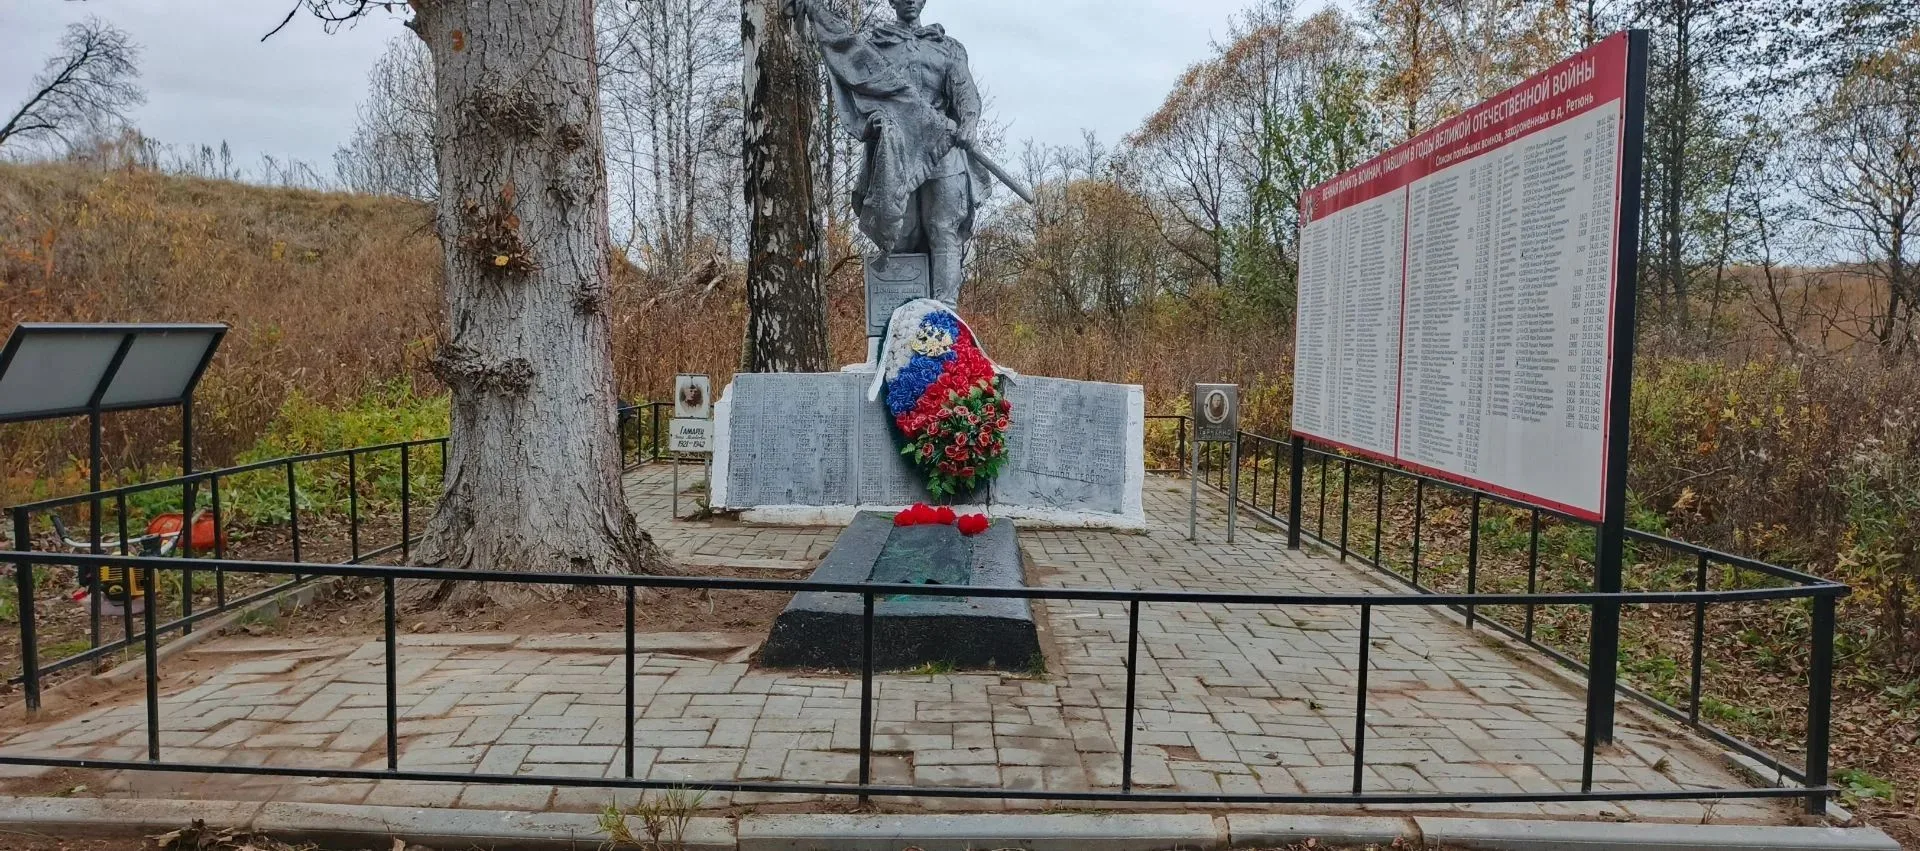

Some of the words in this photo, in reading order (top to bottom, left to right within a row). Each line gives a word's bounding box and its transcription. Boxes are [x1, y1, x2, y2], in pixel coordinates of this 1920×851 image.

[1339, 174, 1358, 193] ПАМЯТЬ
[1358, 164, 1383, 186] ВОИНАМ,
[1383, 152, 1409, 173] ПАВШИМ
[1410, 147, 1415, 161] В
[1415, 139, 1434, 159] ГОДЫ
[1435, 113, 1471, 150] ВЕЛИКОЙ
[1473, 76, 1550, 132] ОТЕЧЕСТВЕННОЙ
[1552, 56, 1595, 96] ВОЙНЫ
[1436, 151, 1452, 167] Список
[1452, 141, 1480, 162] погибших
[1481, 132, 1504, 151] воинов,
[1504, 113, 1550, 139] захороненных
[1551, 109, 1556, 120] в
[1557, 106, 1564, 120] д.
[1566, 95, 1594, 113] Ретюнь
